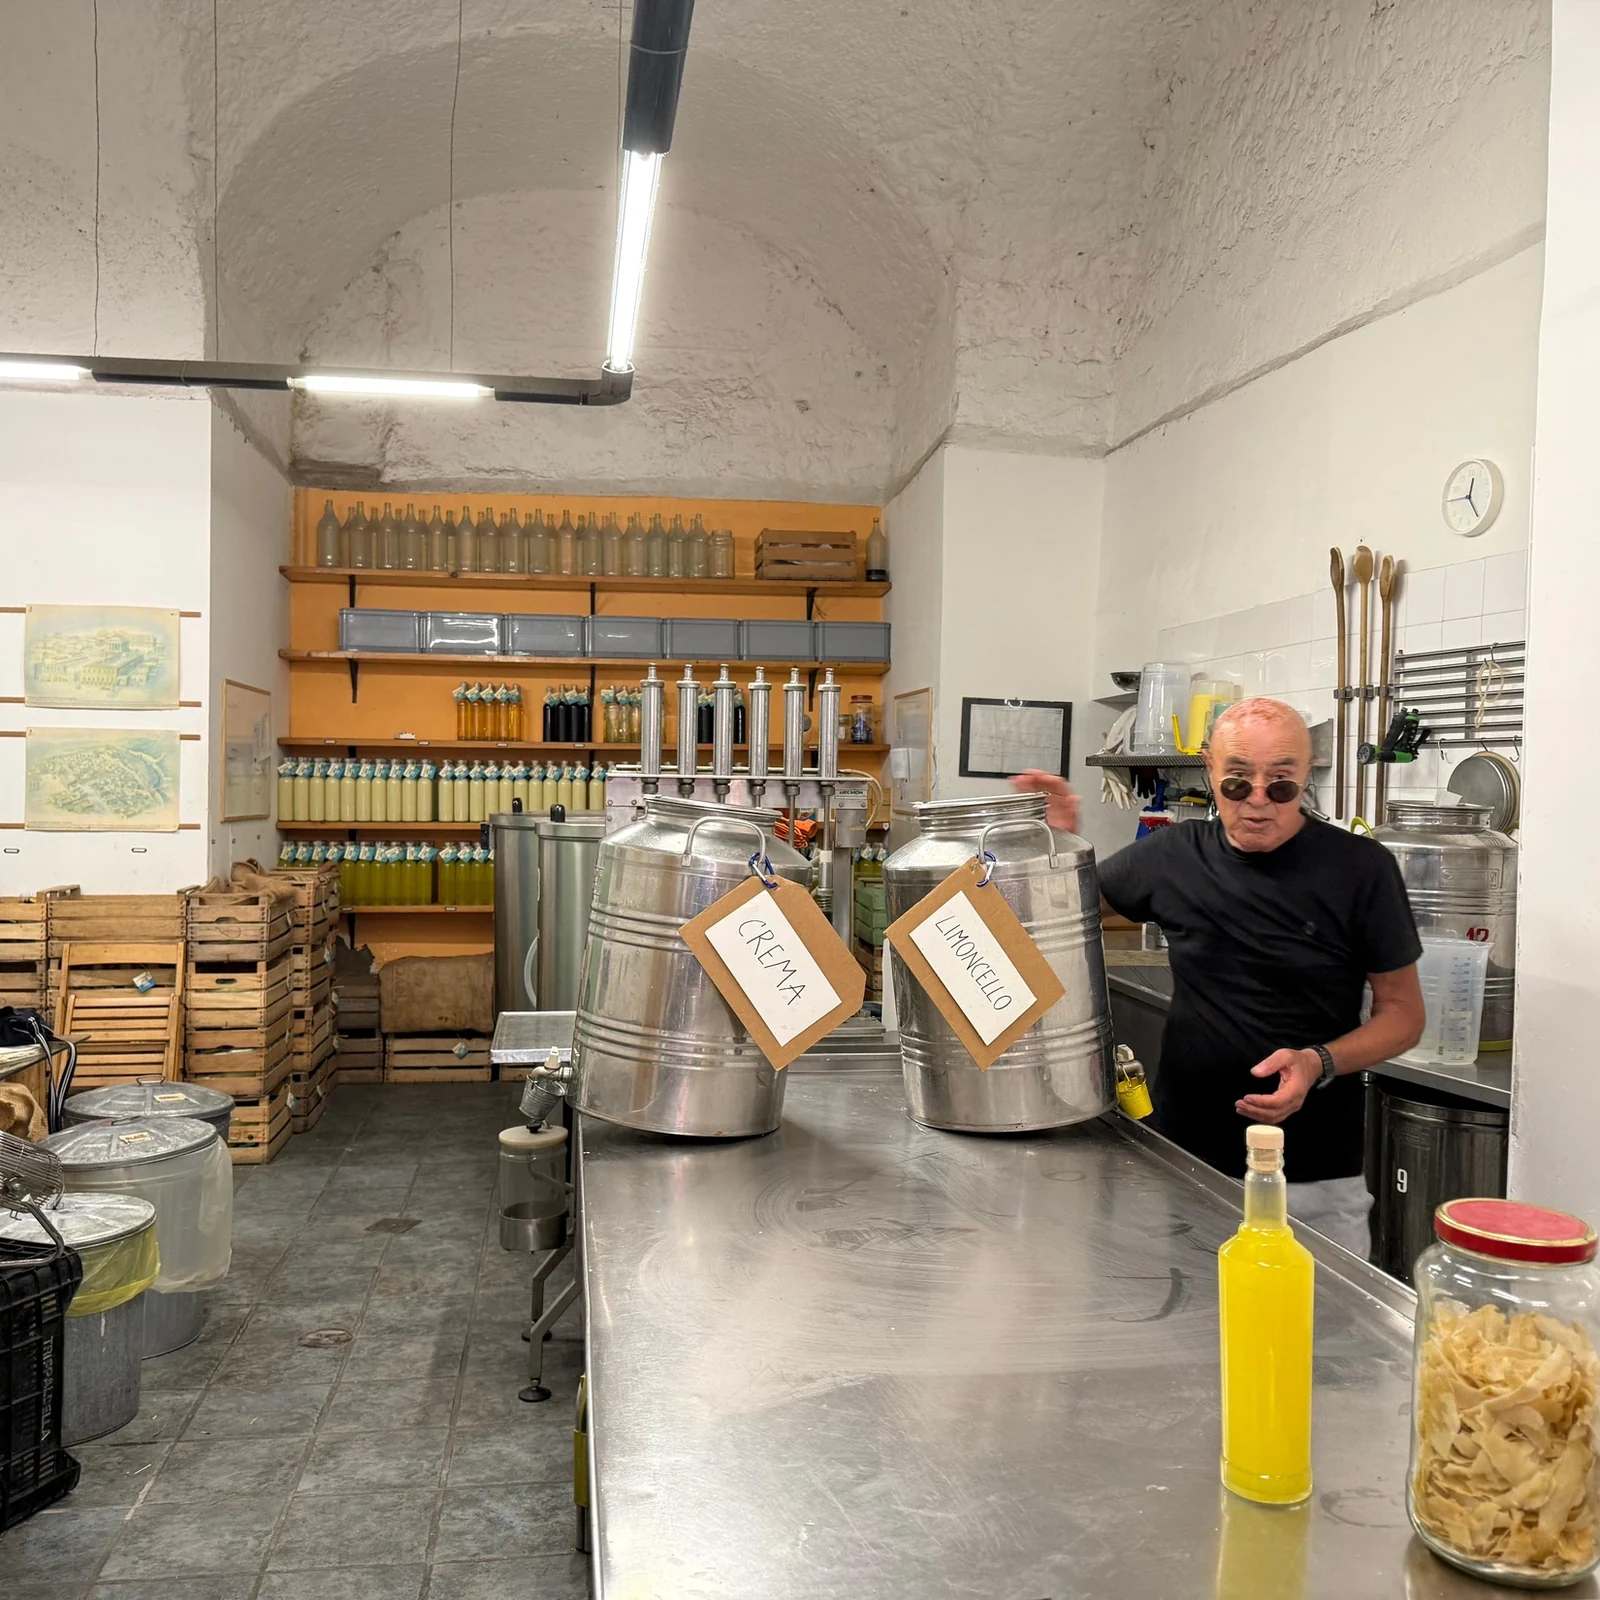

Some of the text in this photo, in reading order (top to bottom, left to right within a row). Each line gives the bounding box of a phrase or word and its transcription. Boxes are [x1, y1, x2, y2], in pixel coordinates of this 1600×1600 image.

[737, 919, 807, 1006] CREMA
[934, 914, 1013, 1011] LIMONCELLO
[1396, 1168, 1408, 1194] 9
